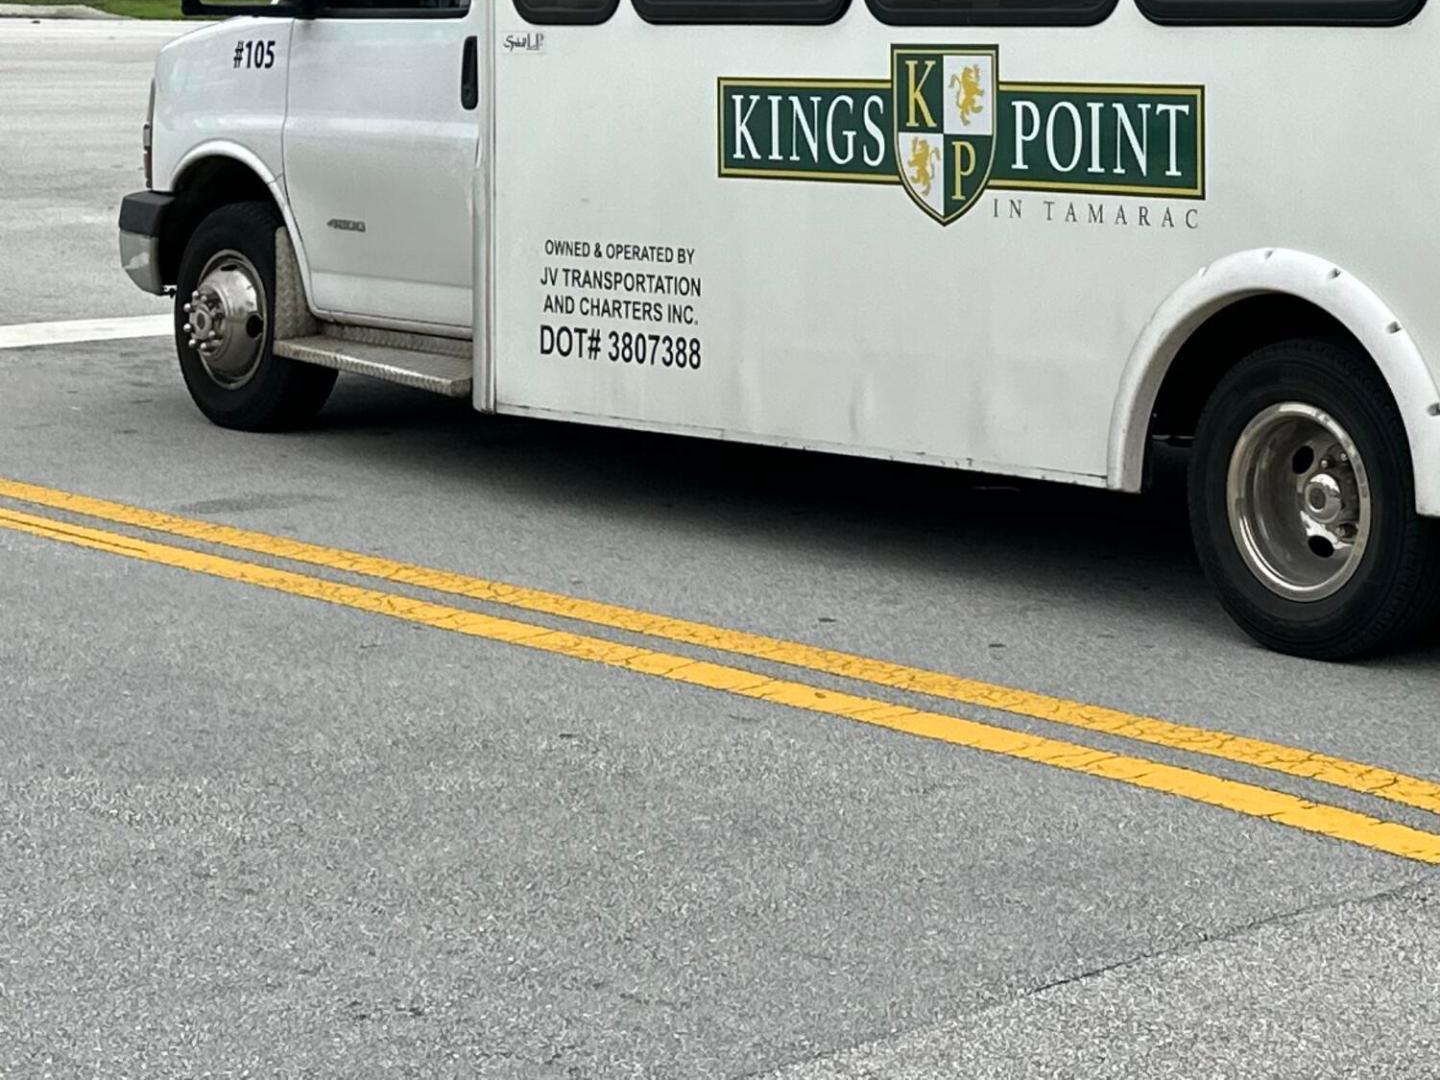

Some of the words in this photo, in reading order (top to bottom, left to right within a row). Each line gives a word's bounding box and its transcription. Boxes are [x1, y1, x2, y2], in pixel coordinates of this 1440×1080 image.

[233, 40, 275, 69] #105
[905, 60, 937, 128] K
[731, 94, 886, 167] KINGS
[1011, 100, 1190, 177] POINT
[951, 140, 977, 201] P
[993, 197, 1023, 219] IN
[1043, 201, 1199, 230] TAMARAC
[545, 239, 591, 258] OWNED
[594, 242, 602, 258] &
[606, 243, 674, 263] OPERATED
[677, 248, 695, 264] BY
[540, 267, 559, 287] JV
[562, 268, 701, 297] TRANSPORTATION
[543, 294, 575, 315] AND
[580, 297, 663, 322] CHARTERS
[667, 304, 699, 326] INC.
[540, 325, 601, 361] DOT#
[608, 330, 701, 370] 3807388
